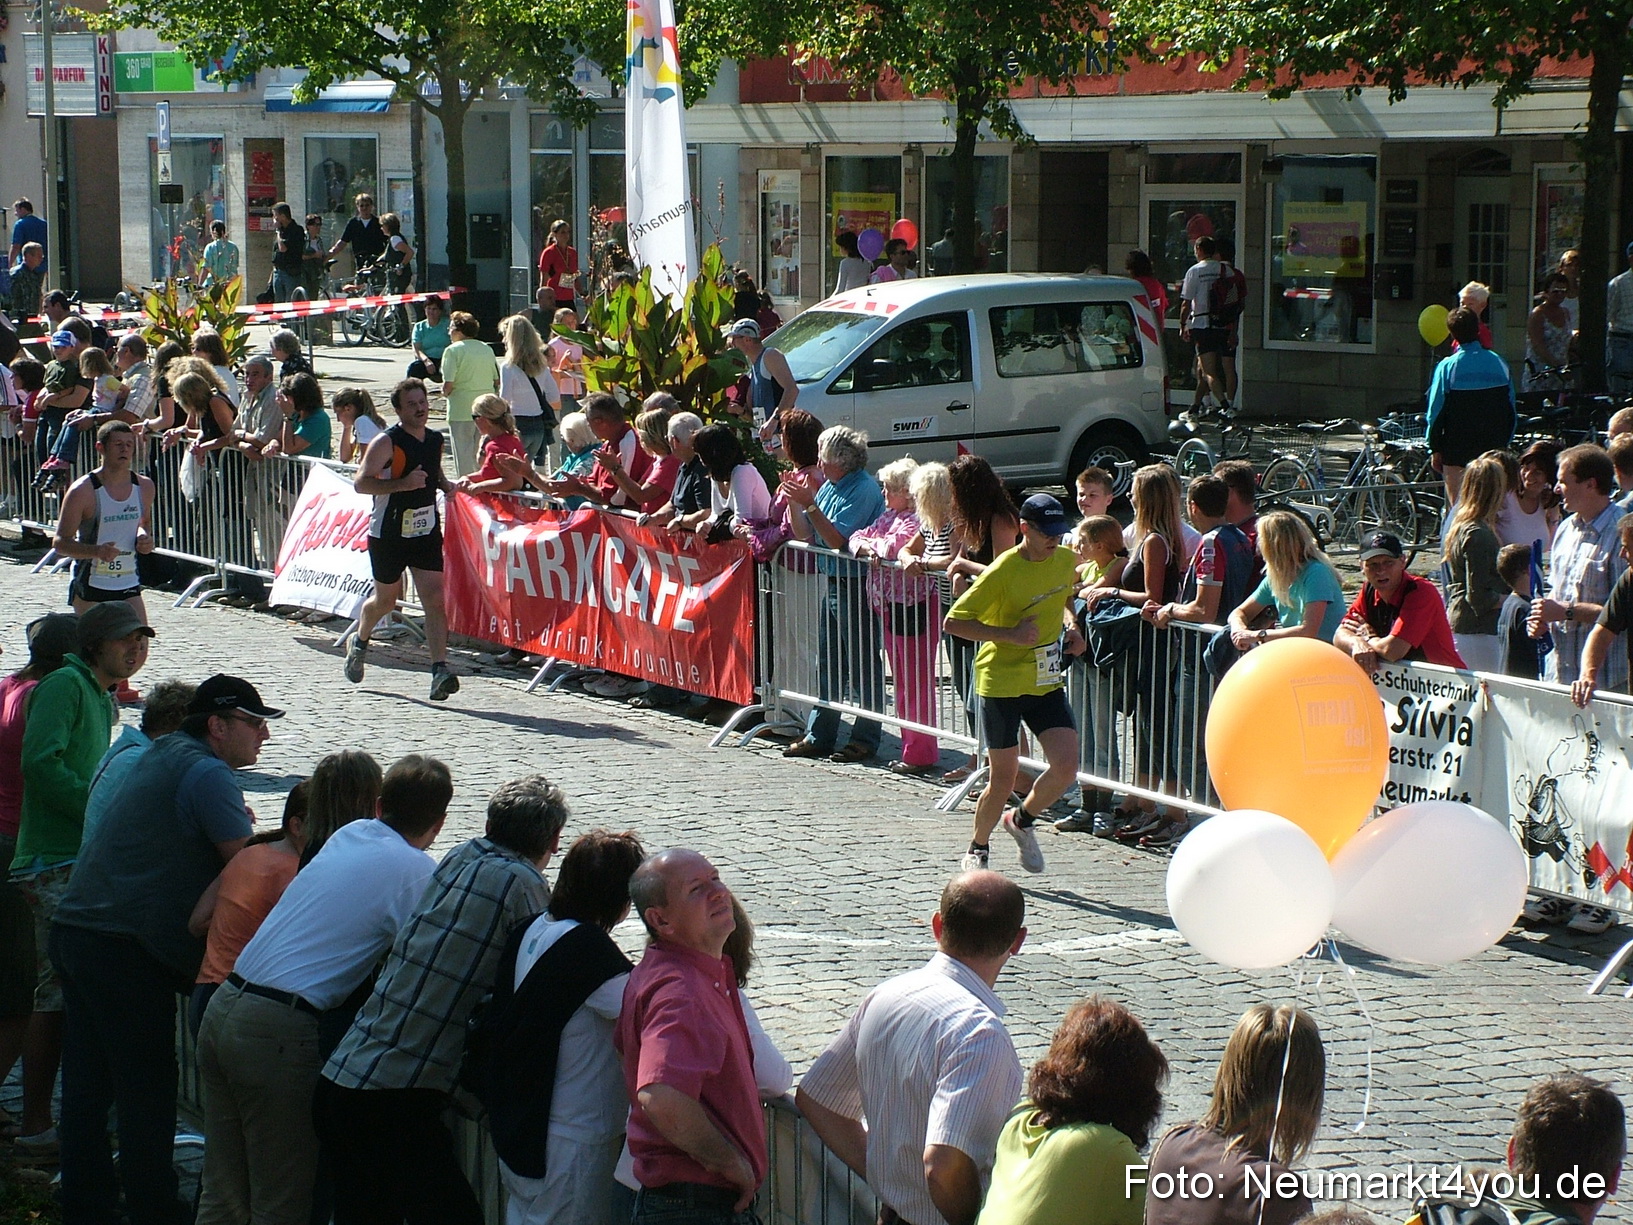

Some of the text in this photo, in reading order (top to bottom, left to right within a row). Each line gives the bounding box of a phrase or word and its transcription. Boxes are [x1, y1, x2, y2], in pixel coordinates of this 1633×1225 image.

[35, 67, 85, 82] DA PARFUM
[98, 37, 110, 112] KINO
[126, 58, 140, 79] 360
[159, 109, 167, 133] P
[893, 422, 920, 432] swn
[103, 512, 140, 524] SIEMENS
[412, 518, 427, 529] 159
[274, 491, 370, 579] Chariva
[108, 560, 122, 571] 85
[287, 564, 340, 590] Ostbayerns
[489, 614, 700, 685] eat drink lounge
[1370, 668, 1479, 703] e-Schuhtechnik
[1390, 695, 1474, 747] Silvia
[1388, 745, 1464, 777] erstr. 21
[1379, 780, 1472, 805] eumarkt
